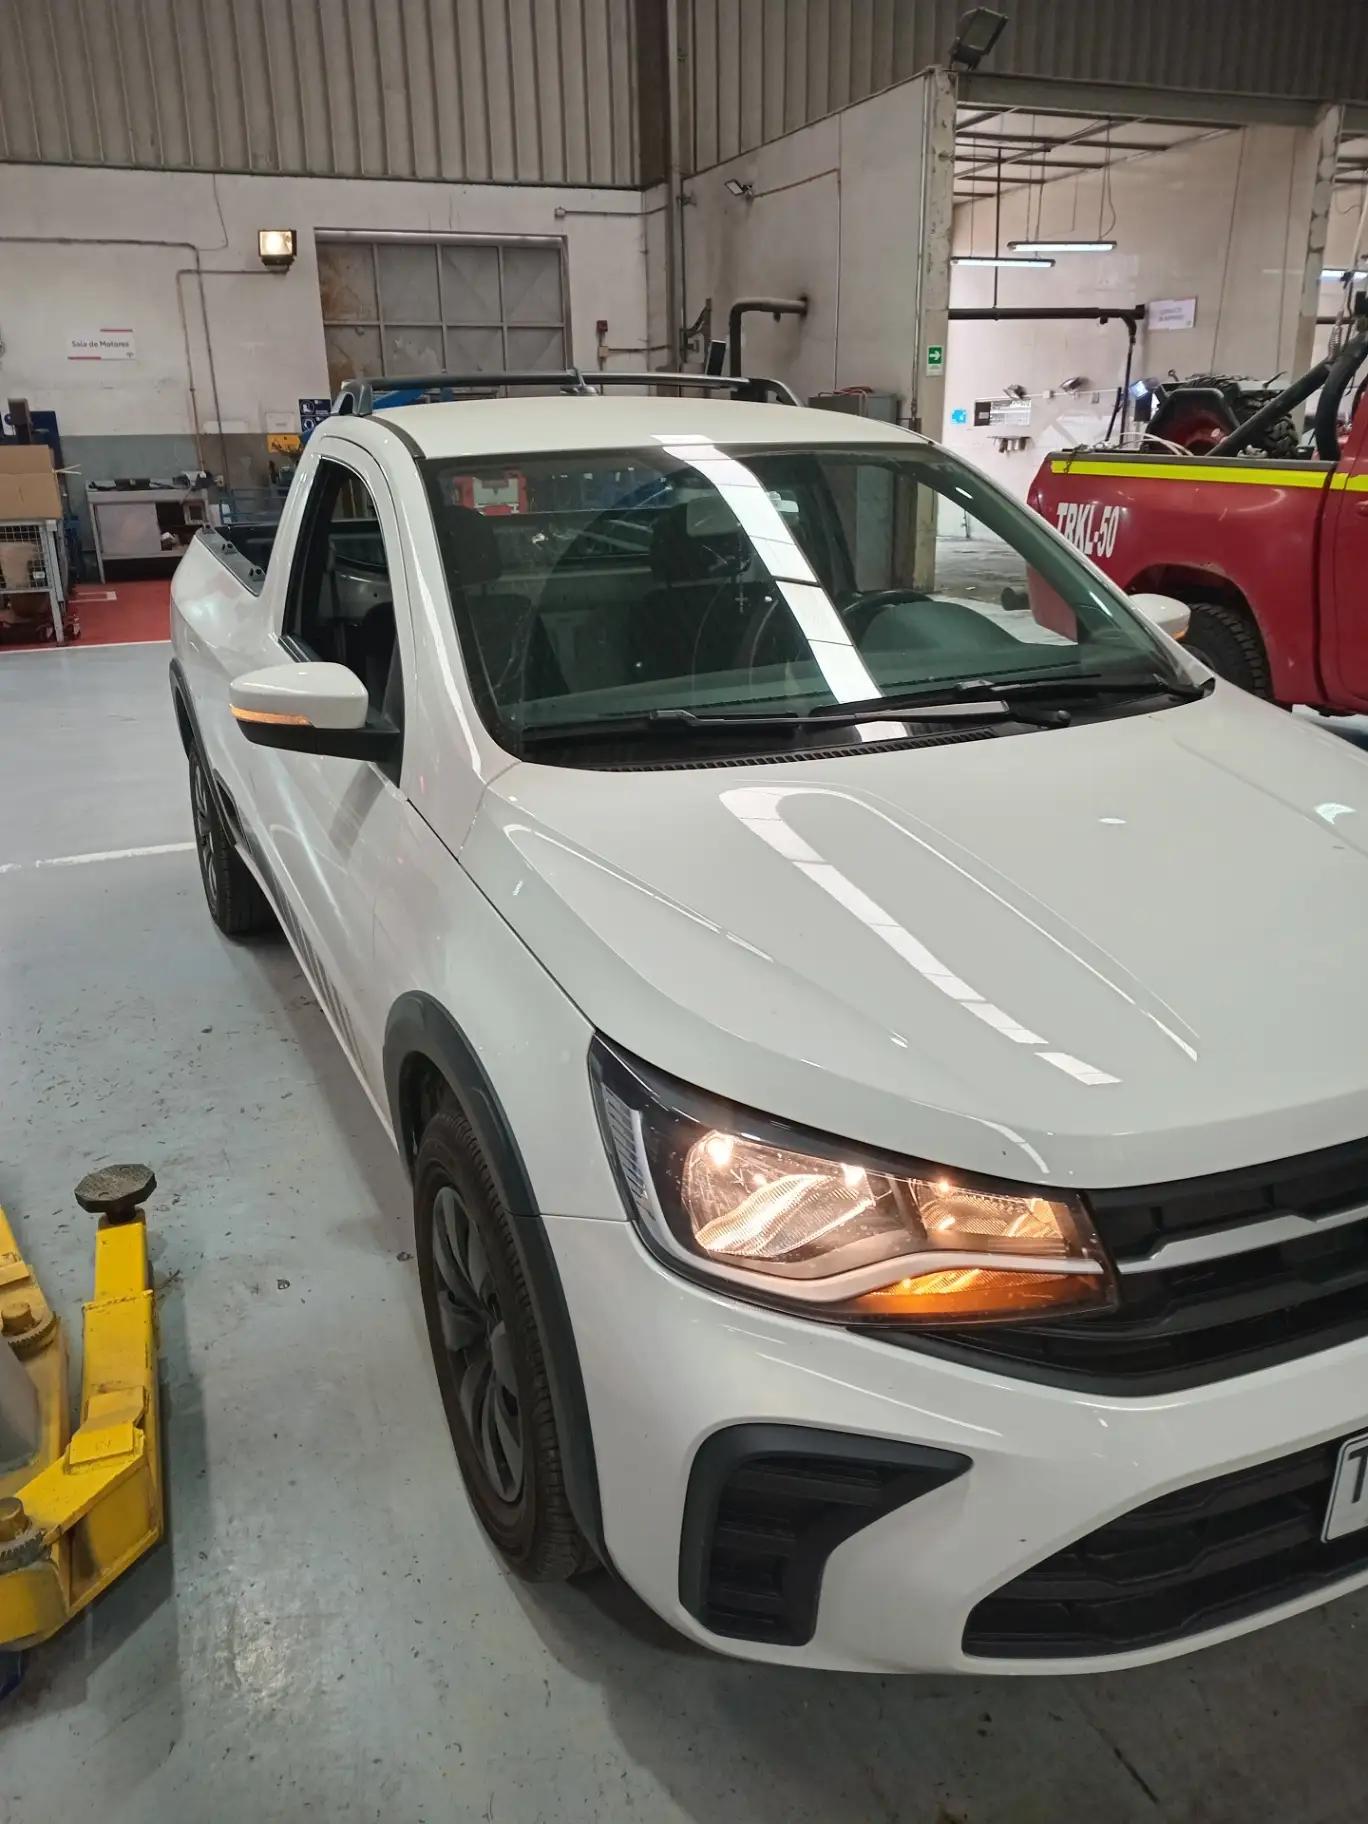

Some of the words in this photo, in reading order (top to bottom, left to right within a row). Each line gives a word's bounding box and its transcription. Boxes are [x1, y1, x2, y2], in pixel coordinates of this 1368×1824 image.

[71, 340, 88, 348] Sala
[88, 340, 99, 348] de
[99, 340, 130, 348] Motores
[1057, 502, 1120, 558] TRKL-50
